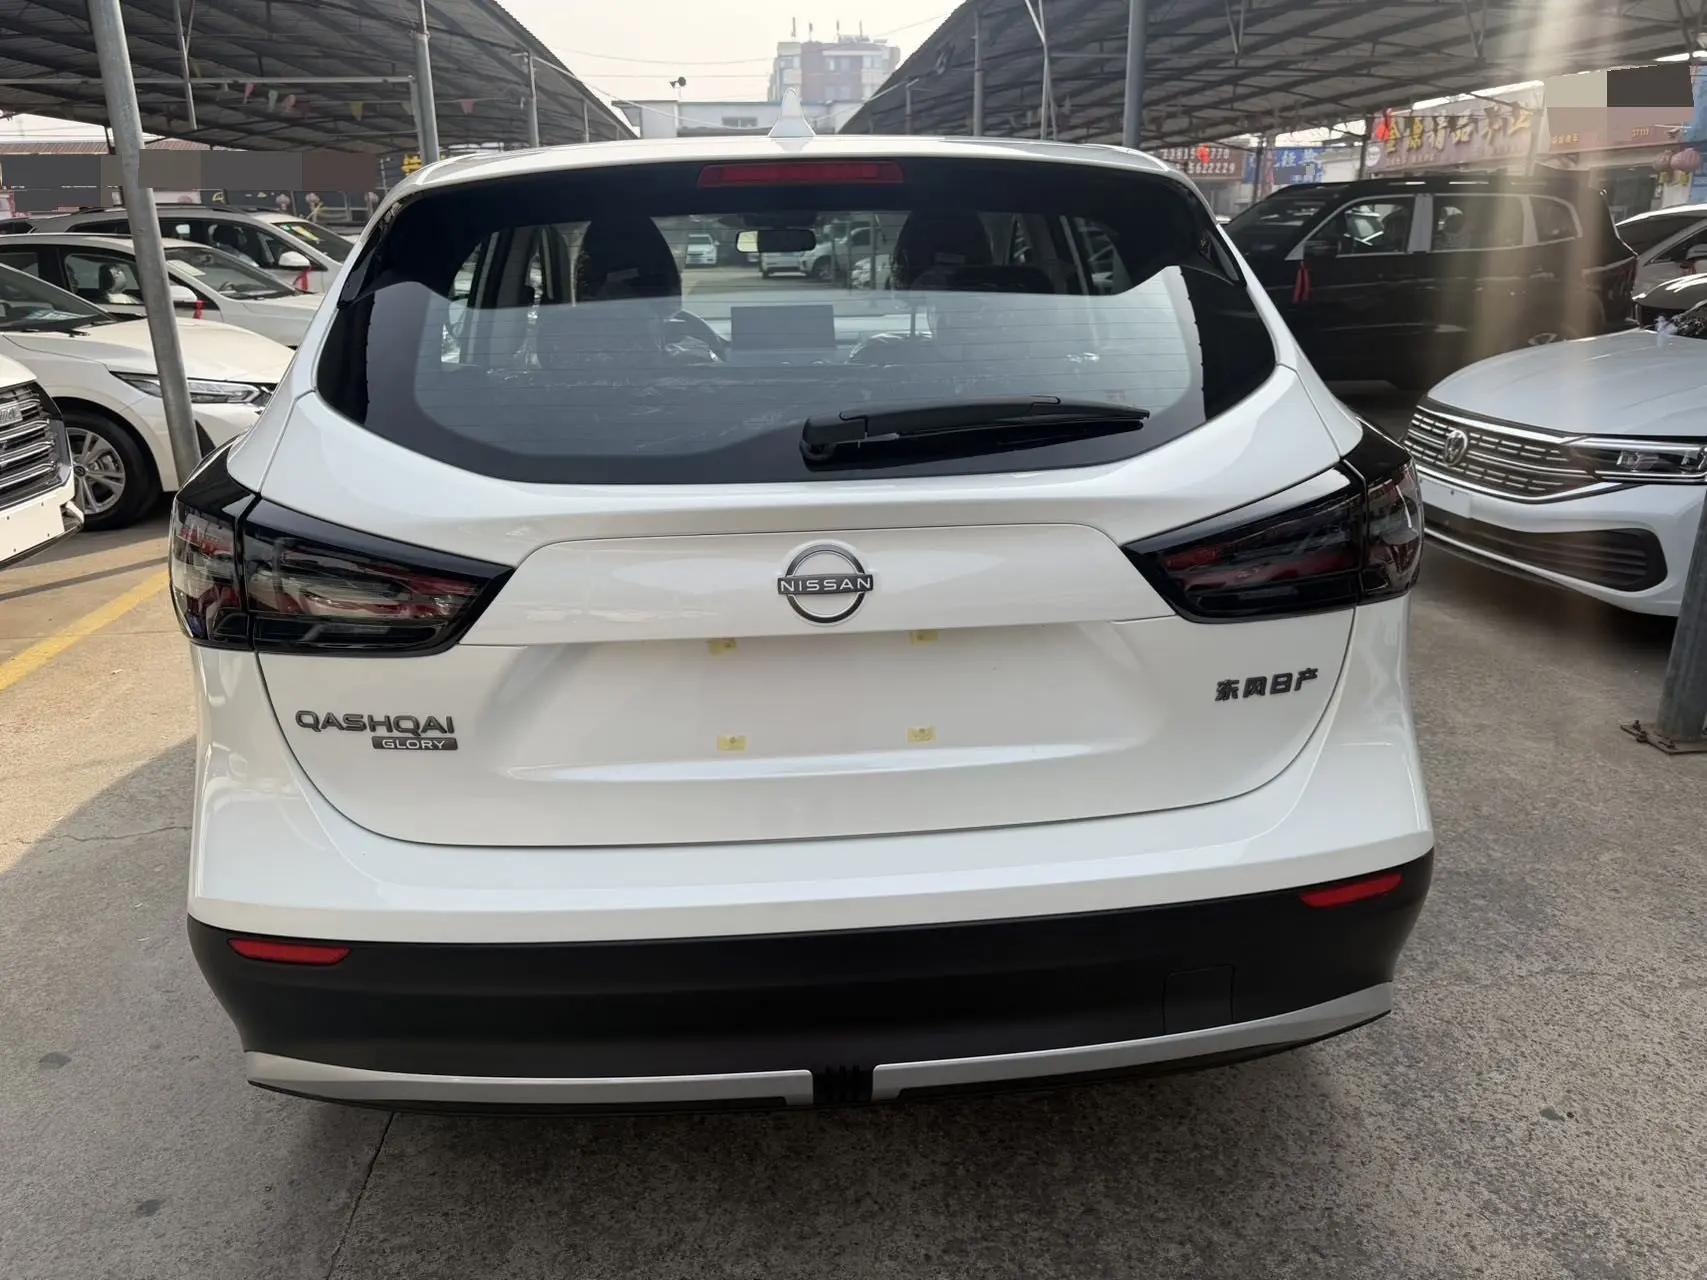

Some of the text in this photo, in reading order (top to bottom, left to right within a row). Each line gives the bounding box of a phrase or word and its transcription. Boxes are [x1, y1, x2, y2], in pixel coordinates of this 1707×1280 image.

[780, 577, 871, 592] NISSAN
[1214, 667, 1319, 702] 东风日产
[295, 710, 455, 737] QASHQAI
[382, 739, 446, 750] GLORY
